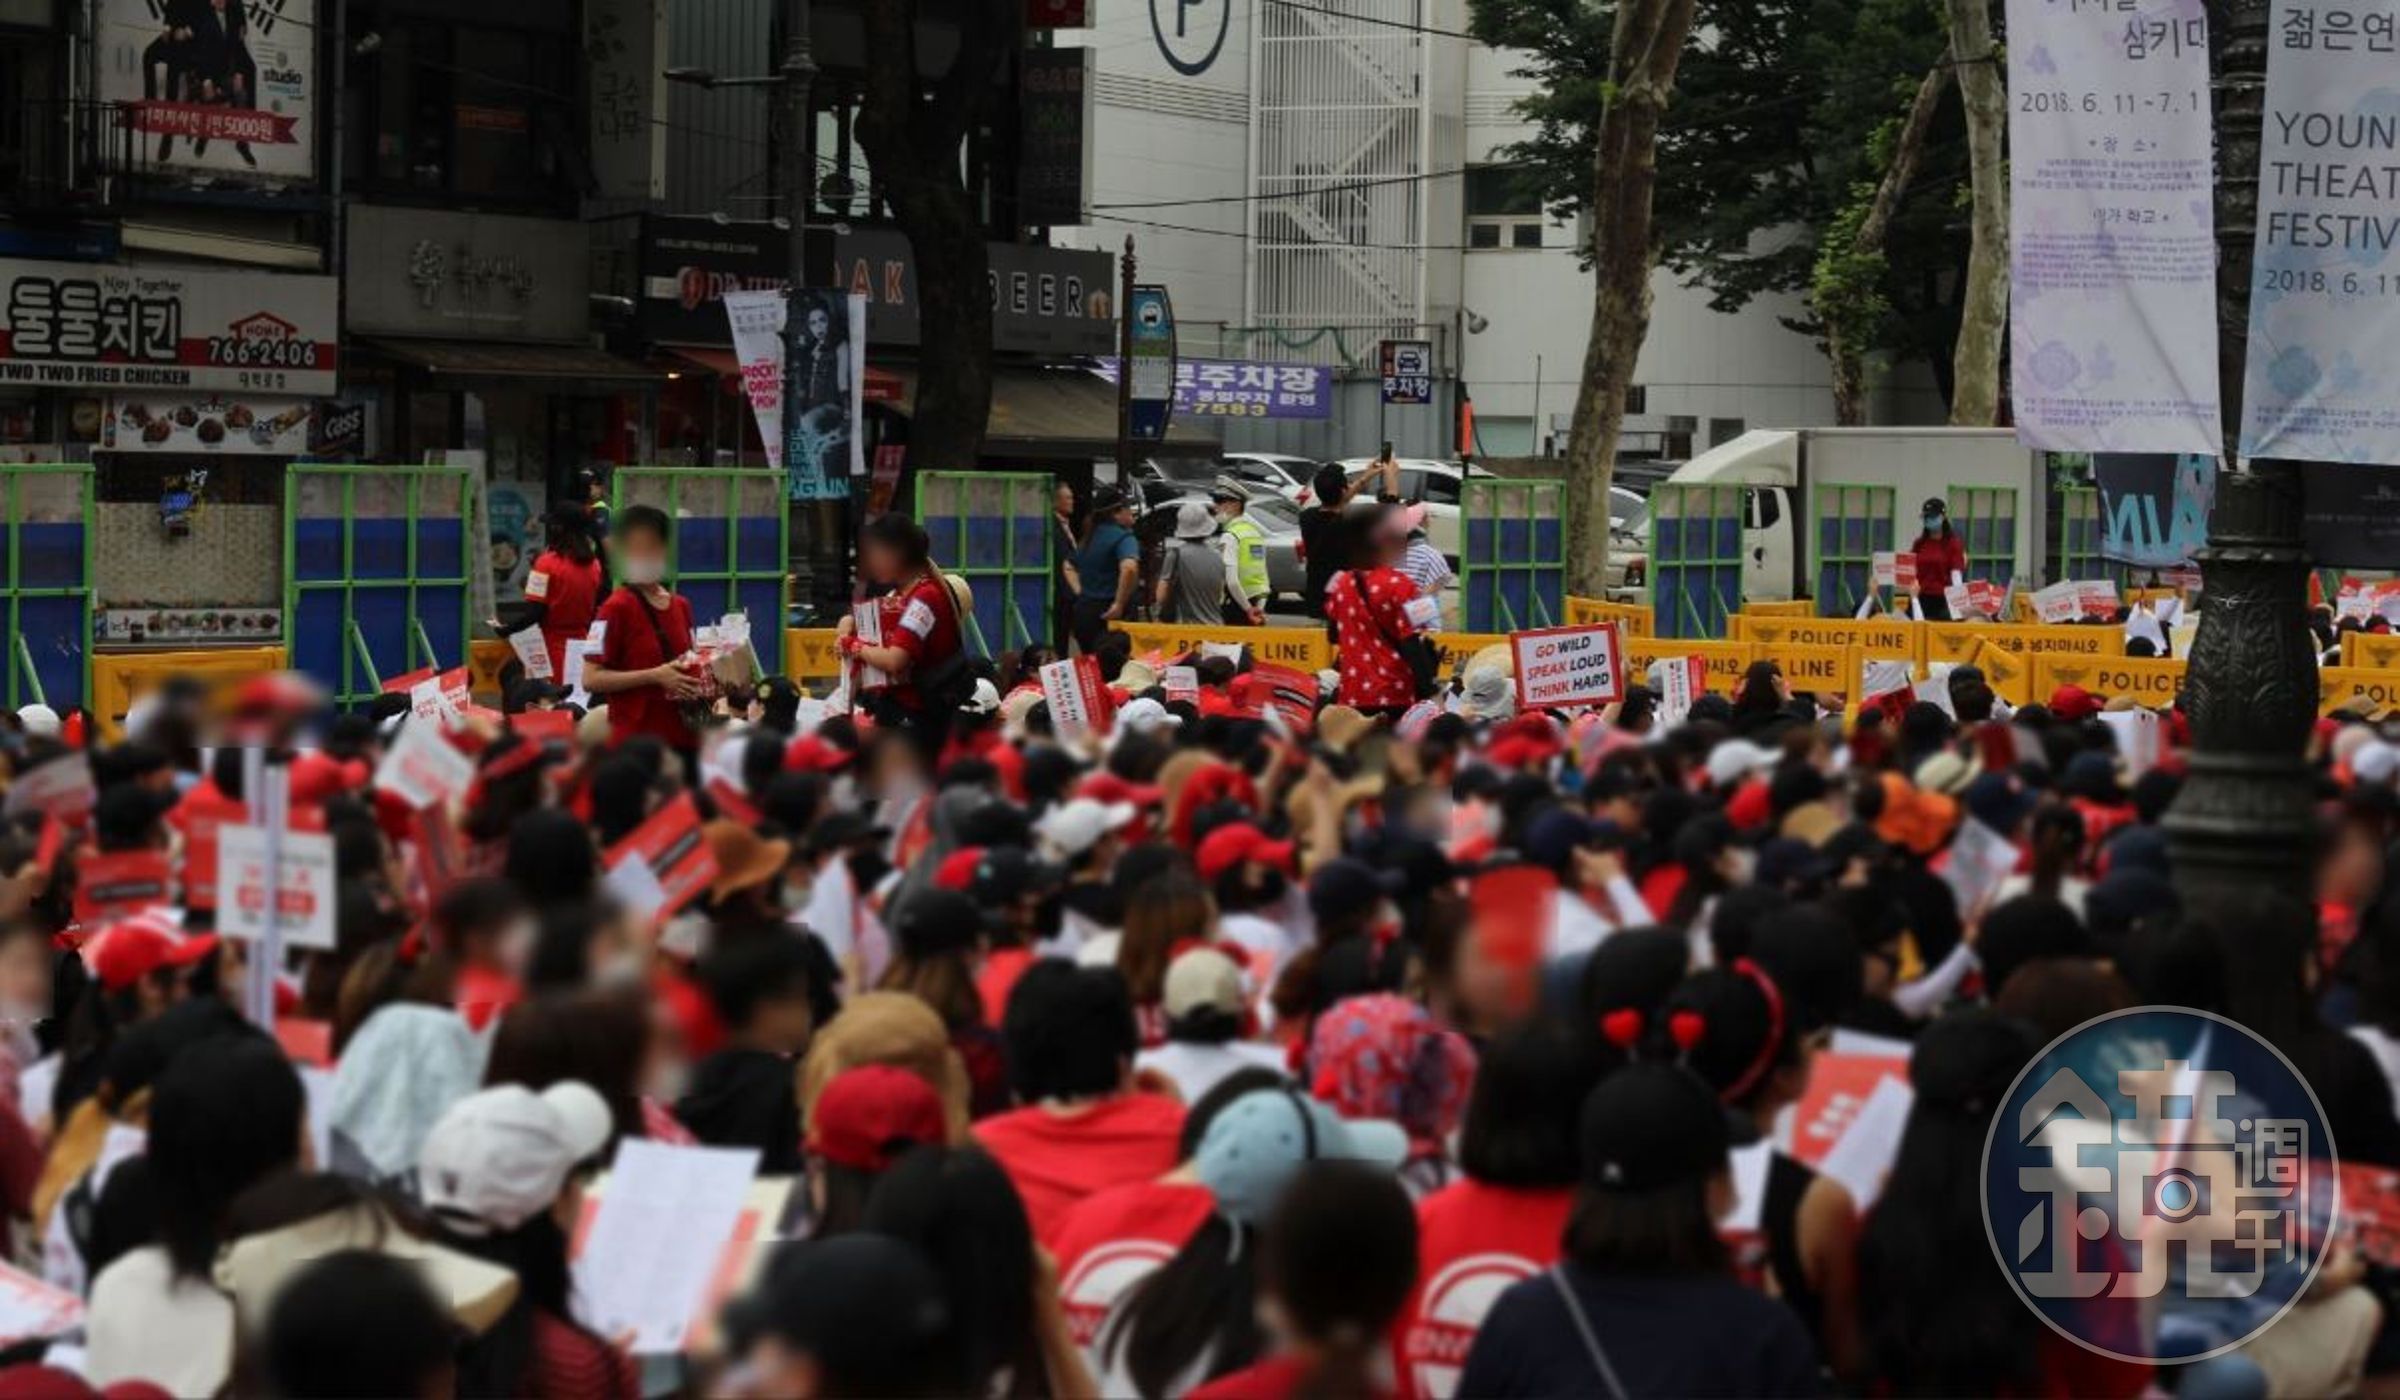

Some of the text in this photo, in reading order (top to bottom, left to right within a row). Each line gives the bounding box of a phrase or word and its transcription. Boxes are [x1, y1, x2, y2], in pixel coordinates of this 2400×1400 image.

[2020, 92, 2074, 113] 2018.
[2264, 269, 2332, 294] 2018.
[245, 325, 282, 337] HOME
[38, 365, 75, 382] TWO
[78, 366, 121, 383] FRIED
[124, 368, 191, 385] CHICKEN
[1383, 377, 1430, 398] 주차장
[1535, 636, 1592, 659] GO WILD
[1865, 632, 1904, 649] LINE
[1264, 643, 1309, 661] LINE
[1527, 662, 1567, 680] SPEAK
[1569, 653, 1607, 672] LOUD
[1789, 658, 1836, 678] LINE
[1530, 672, 1609, 699] THINK HARD
[2098, 671, 2184, 694] POLICE
